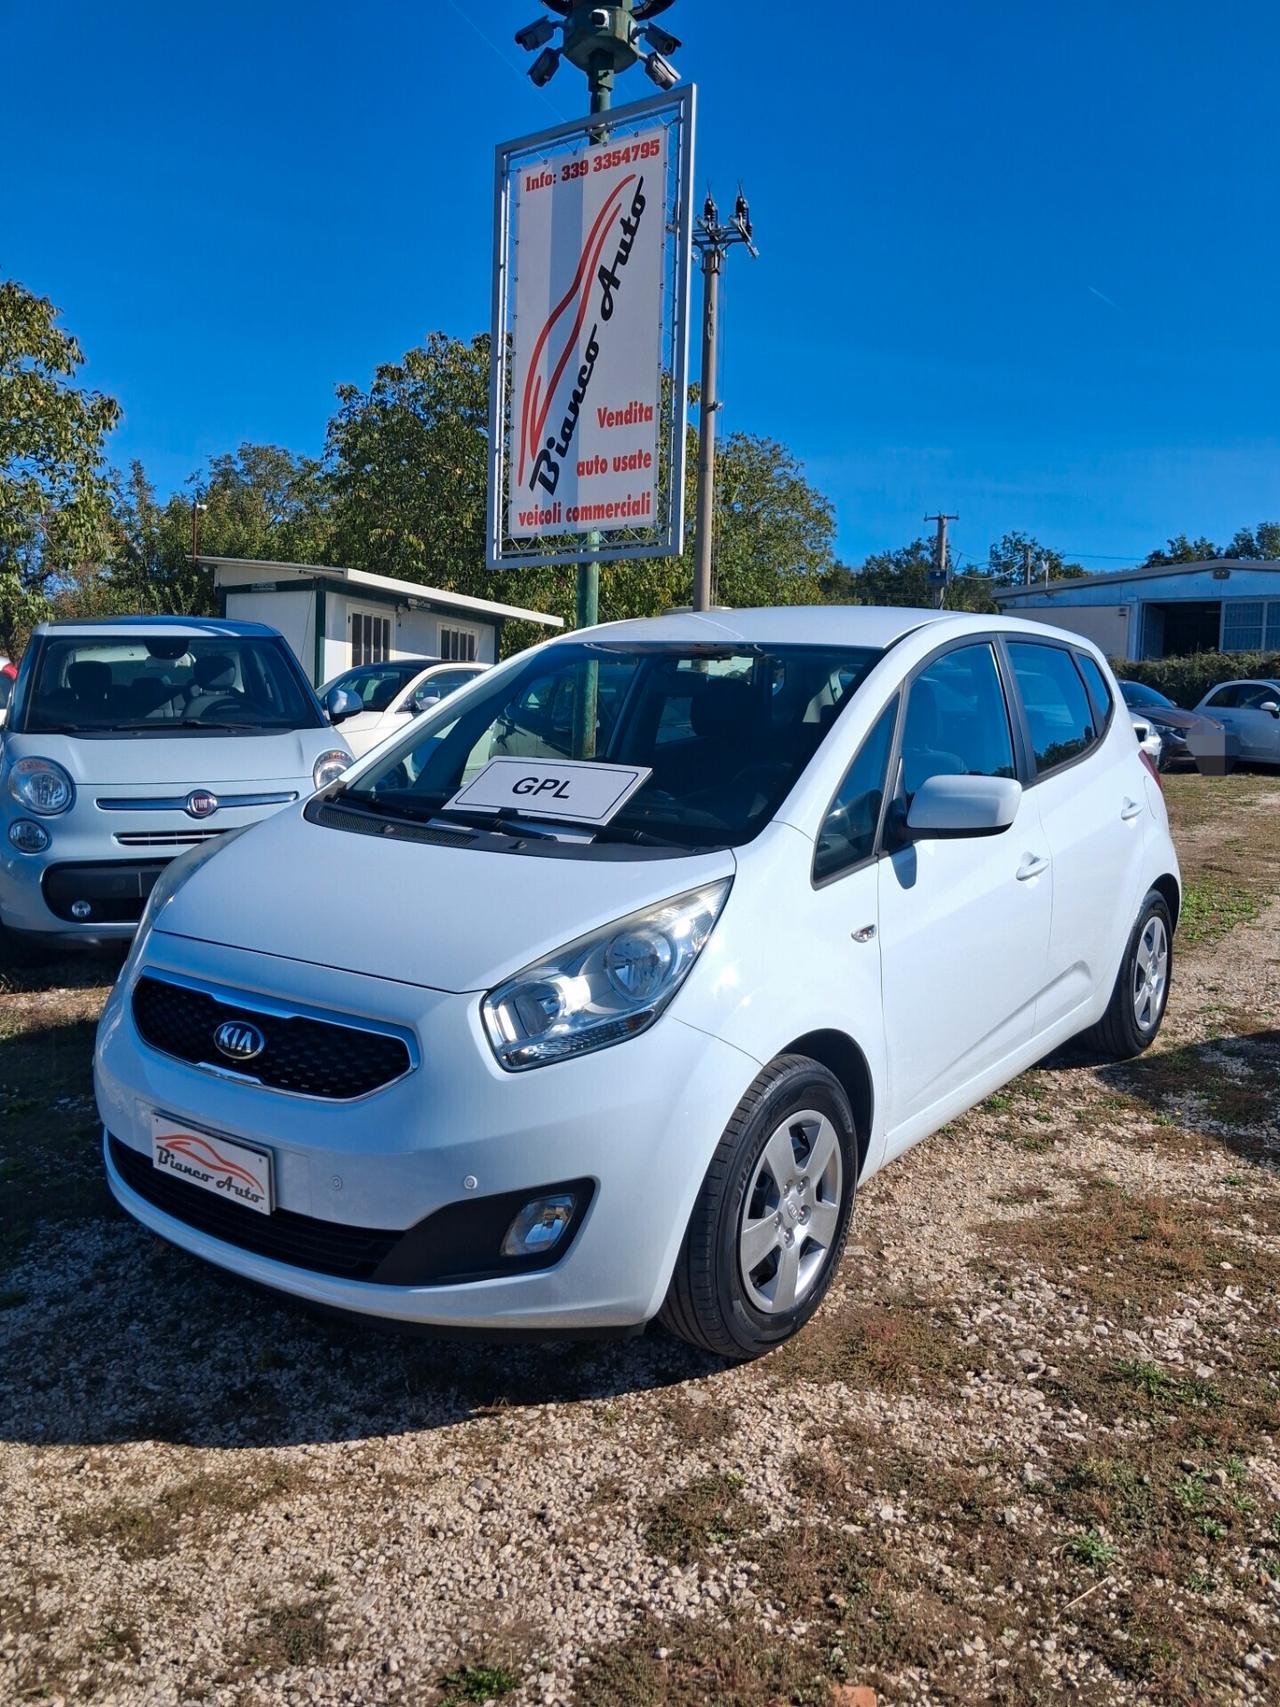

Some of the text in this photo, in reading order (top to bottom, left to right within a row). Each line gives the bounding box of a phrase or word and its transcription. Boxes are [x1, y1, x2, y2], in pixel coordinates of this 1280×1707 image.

[525, 139, 660, 192] Info: 339 3354795
[529, 175, 646, 496] Bianco Auto
[597, 401, 653, 428] Vendita
[576, 449, 652, 477] auto usate
[518, 491, 651, 526] veicoli commerciali
[512, 776, 570, 799] GPL
[218, 1025, 252, 1053] KIA
[156, 1145, 264, 1203] Bianco Auto
